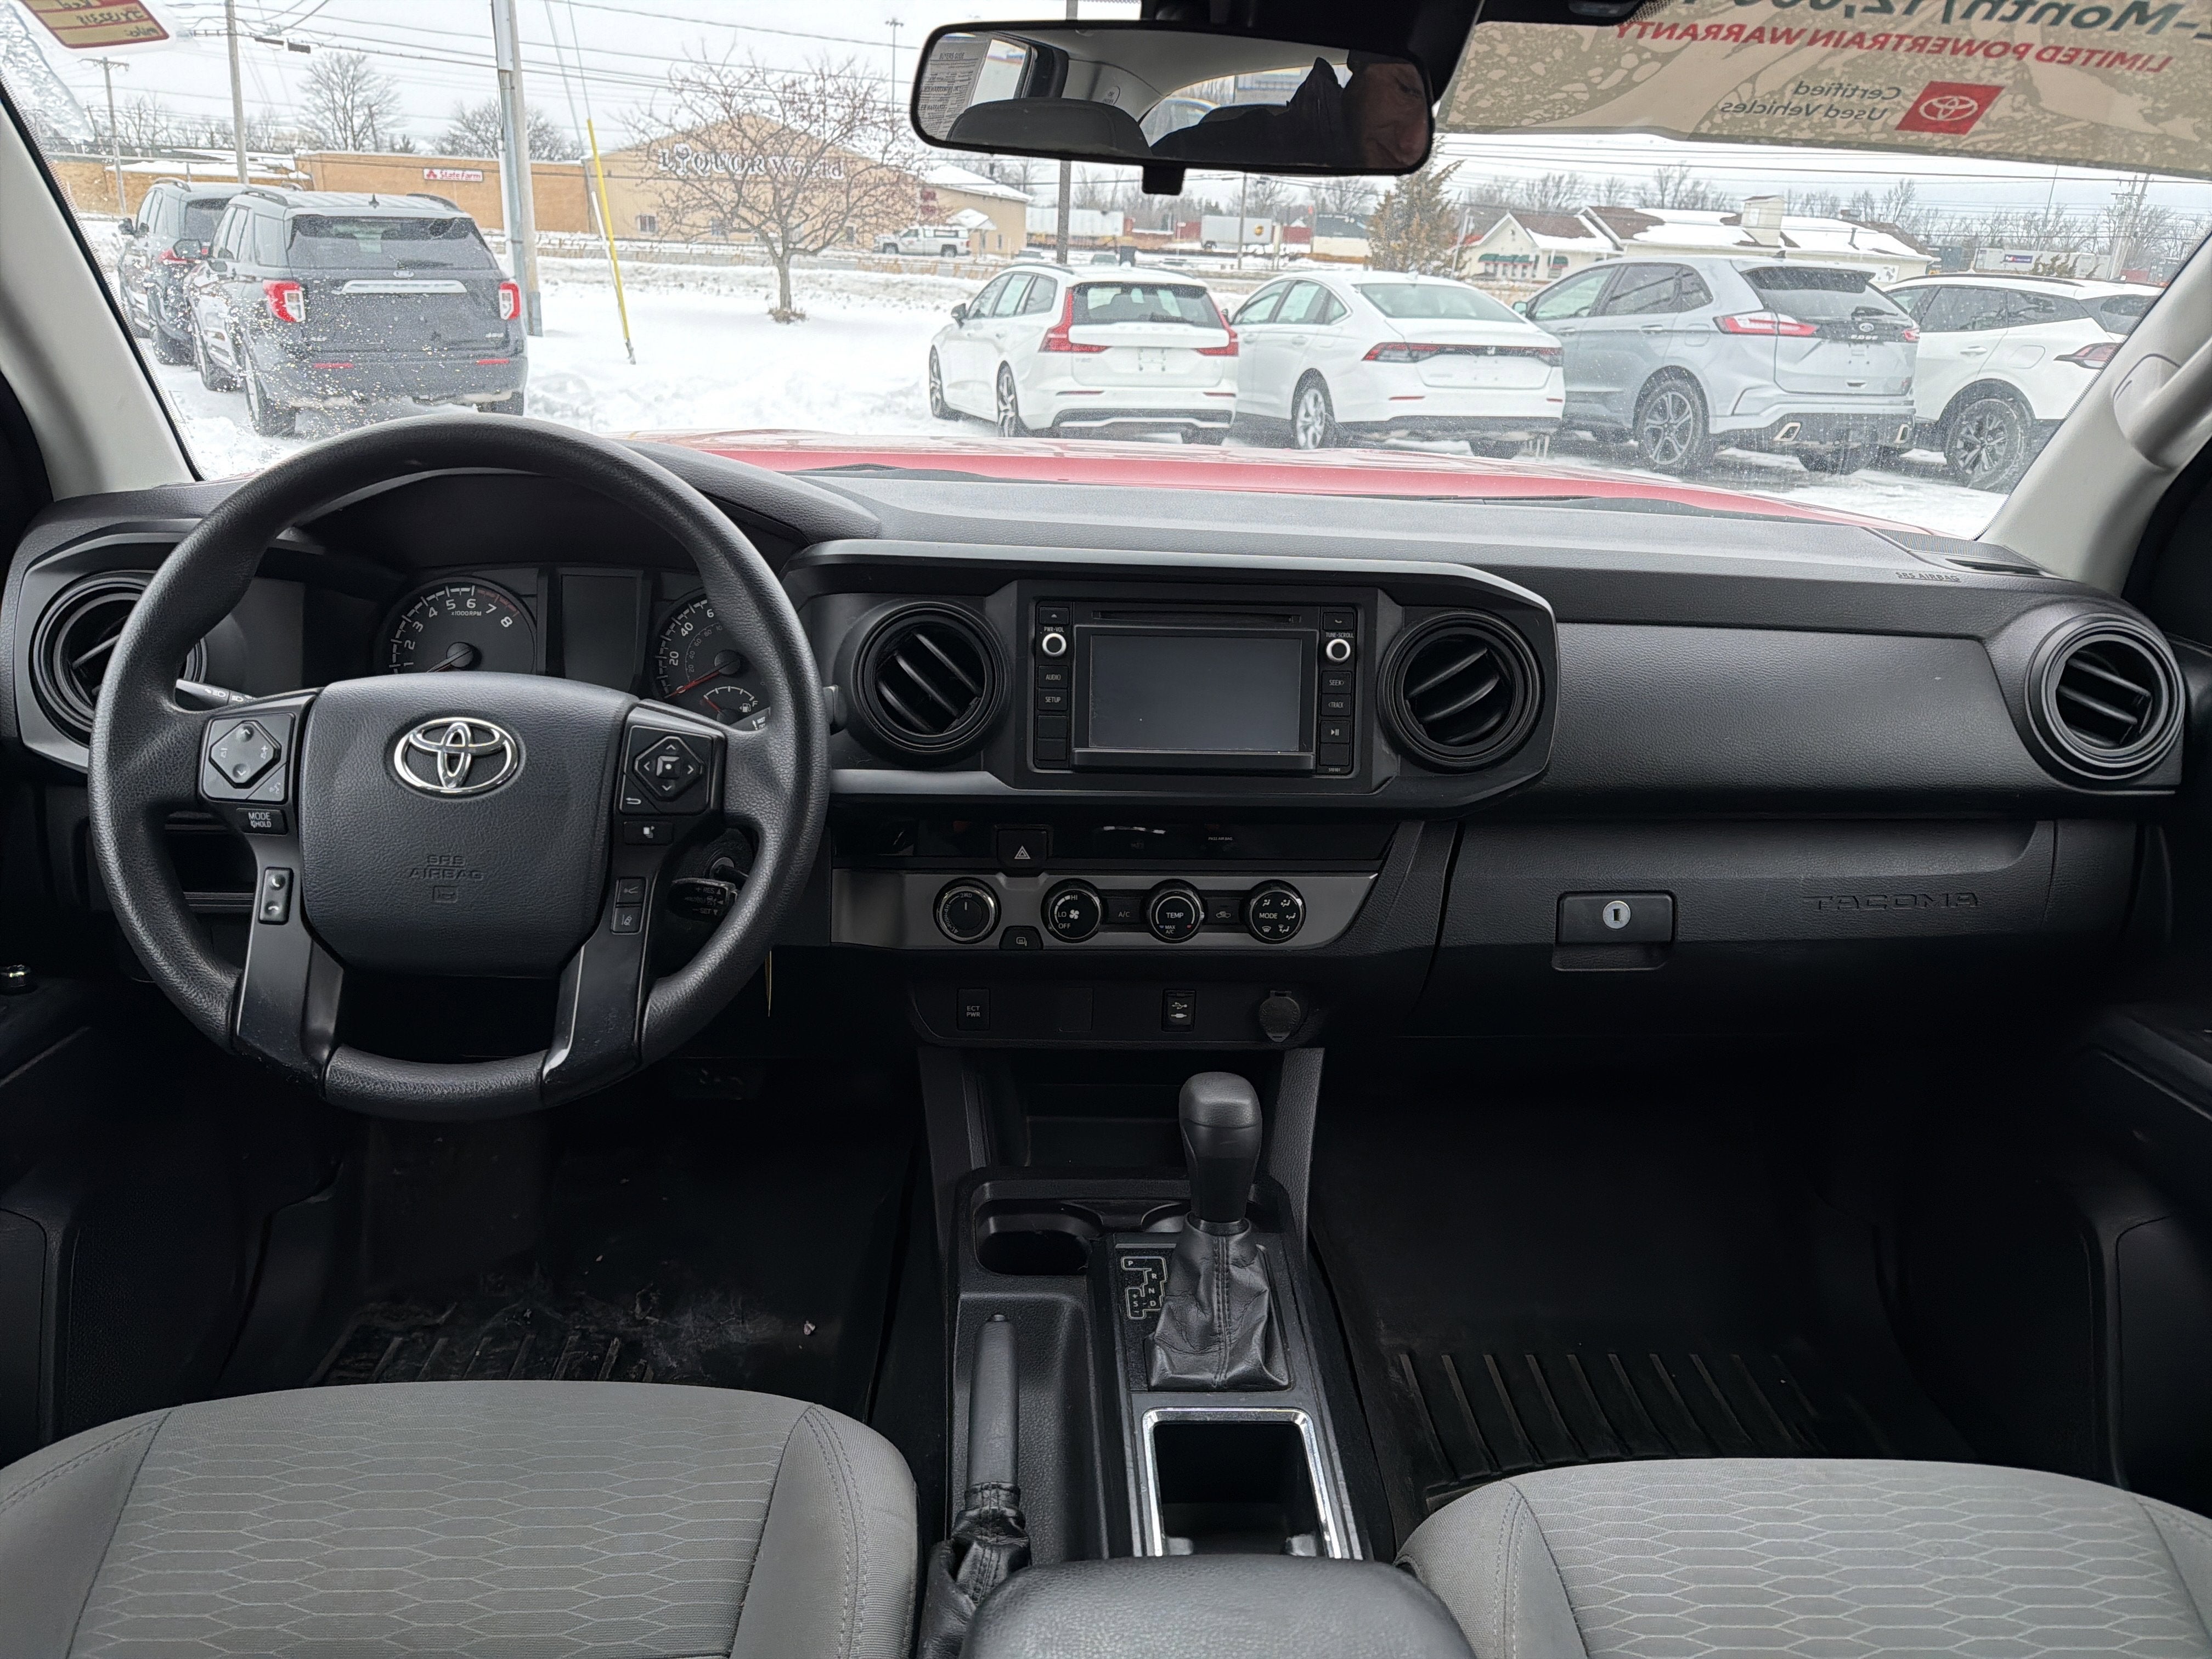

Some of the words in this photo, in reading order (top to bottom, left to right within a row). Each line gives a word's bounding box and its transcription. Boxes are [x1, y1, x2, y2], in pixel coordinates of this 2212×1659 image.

[1918, 573, 1961, 582] AIRBAG
[445, 599, 456, 610] 5
[466, 599, 476, 609] 6
[486, 603, 497, 614] 7
[428, 606, 438, 618] 4
[412, 621, 424, 633] 3
[500, 616, 513, 628] 8
[680, 622, 694, 637] 40
[404, 639, 416, 650] 2
[694, 638, 702, 647] 60
[669, 651, 679, 666] 20
[688, 664, 695, 673] 20
[248, 812, 272, 821] MODE
[427, 854, 466, 866] SRS
[409, 868, 484, 882] AIRBAG
[1804, 893, 1982, 911] TACOMA
